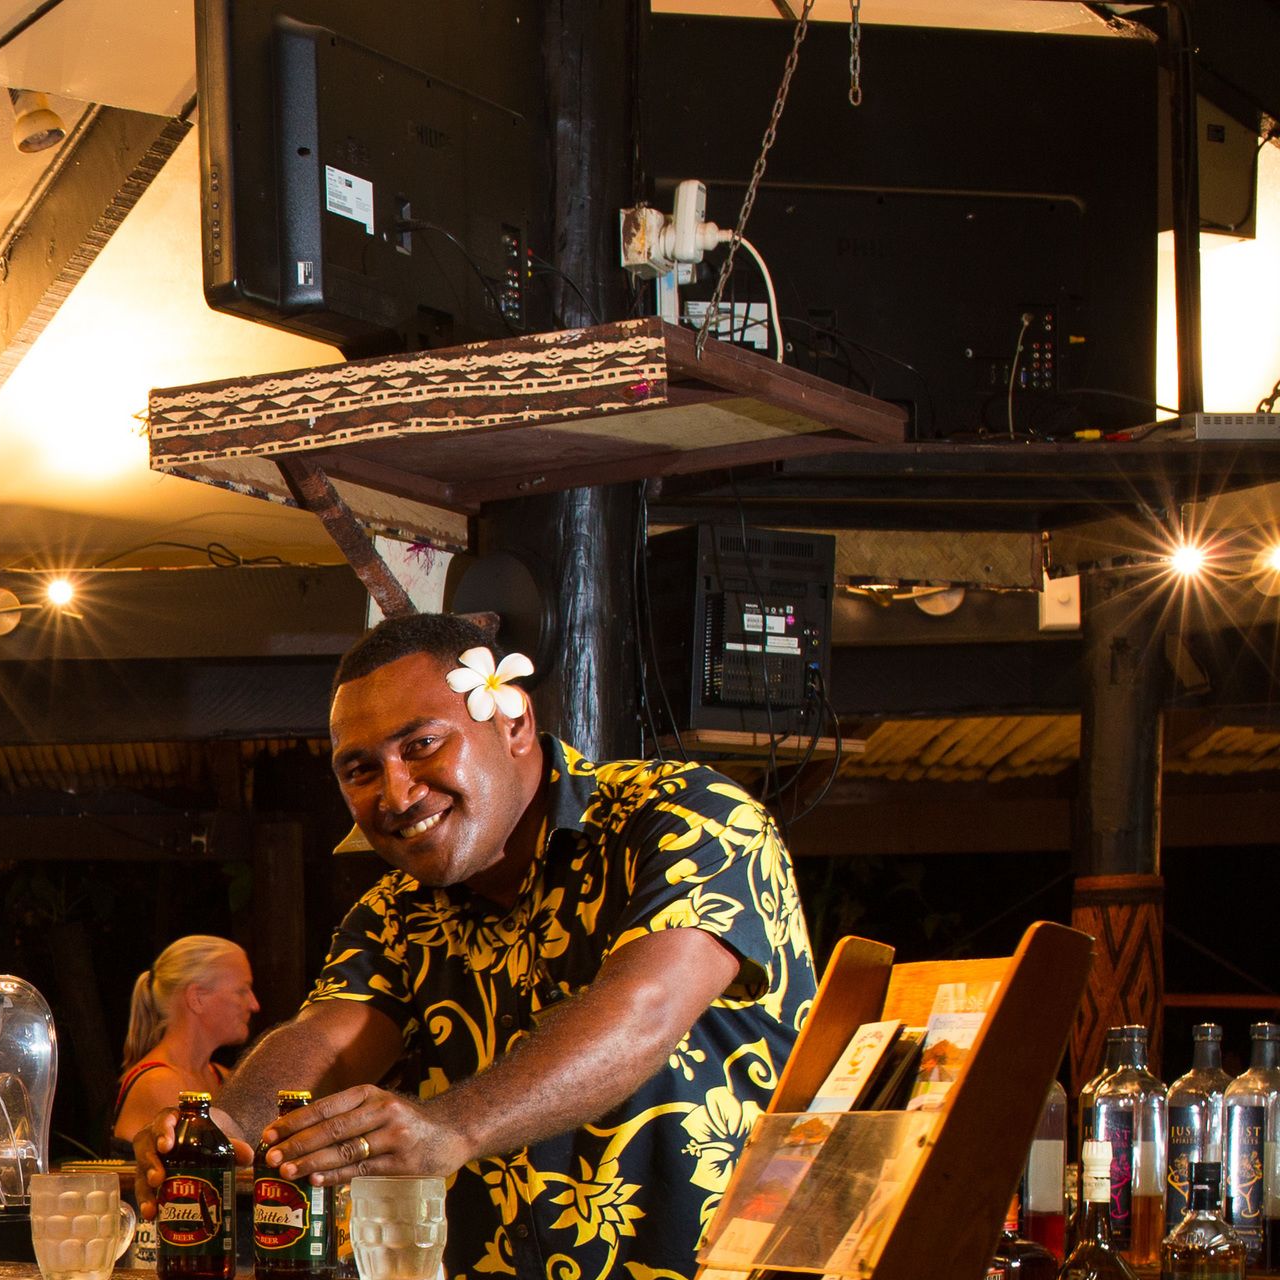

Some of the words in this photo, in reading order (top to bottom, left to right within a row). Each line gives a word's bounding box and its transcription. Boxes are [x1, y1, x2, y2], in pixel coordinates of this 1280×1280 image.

[255, 1208, 290, 1224] Bitter
[172, 1233, 195, 1241] BEER
[260, 1235, 279, 1245] BEER
